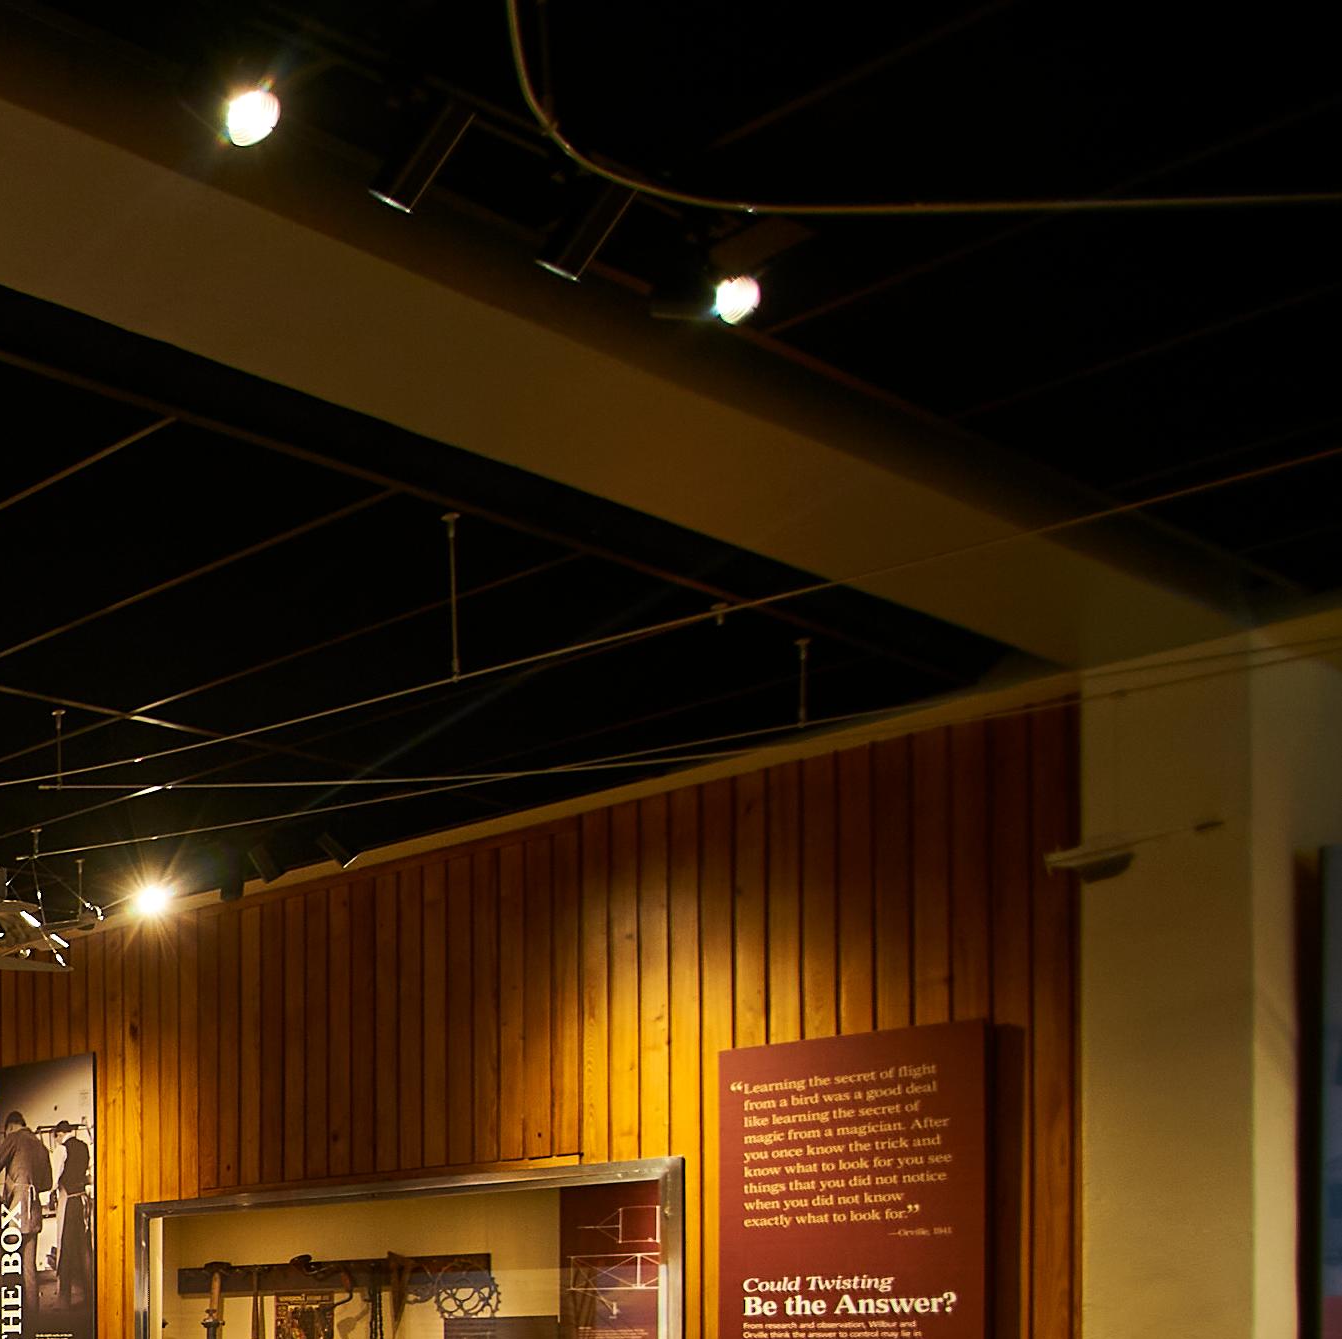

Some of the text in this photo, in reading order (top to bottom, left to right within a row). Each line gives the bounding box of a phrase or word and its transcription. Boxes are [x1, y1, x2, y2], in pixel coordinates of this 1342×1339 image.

[808, 1075, 831, 1087] the
[834, 1071, 875, 1084] secret
[879, 1067, 894, 1079] of
[898, 1064, 935, 1078] flight
[743, 1081, 936, 1111] from a bird was a good deal
[743, 1100, 919, 1127] like learning the secret of
[743, 1117, 949, 1145] magic from a magician. After
[743, 1134, 940, 1163] you once know the trick and
[744, 1154, 951, 1177] know what to look for you see
[743, 1171, 946, 1194] things that you did not notice
[743, 1192, 903, 1210] when you did not know
[743, 1214, 792, 1227] exactly
[795, 1213, 829, 1224] what
[832, 1213, 846, 1222] to
[850, 1209, 880, 1221] look
[1, 1201, 23, 1276] BOX
[743, 1275, 893, 1293] Could Twisting
[743, 1292, 956, 1316] Be the Answer?
